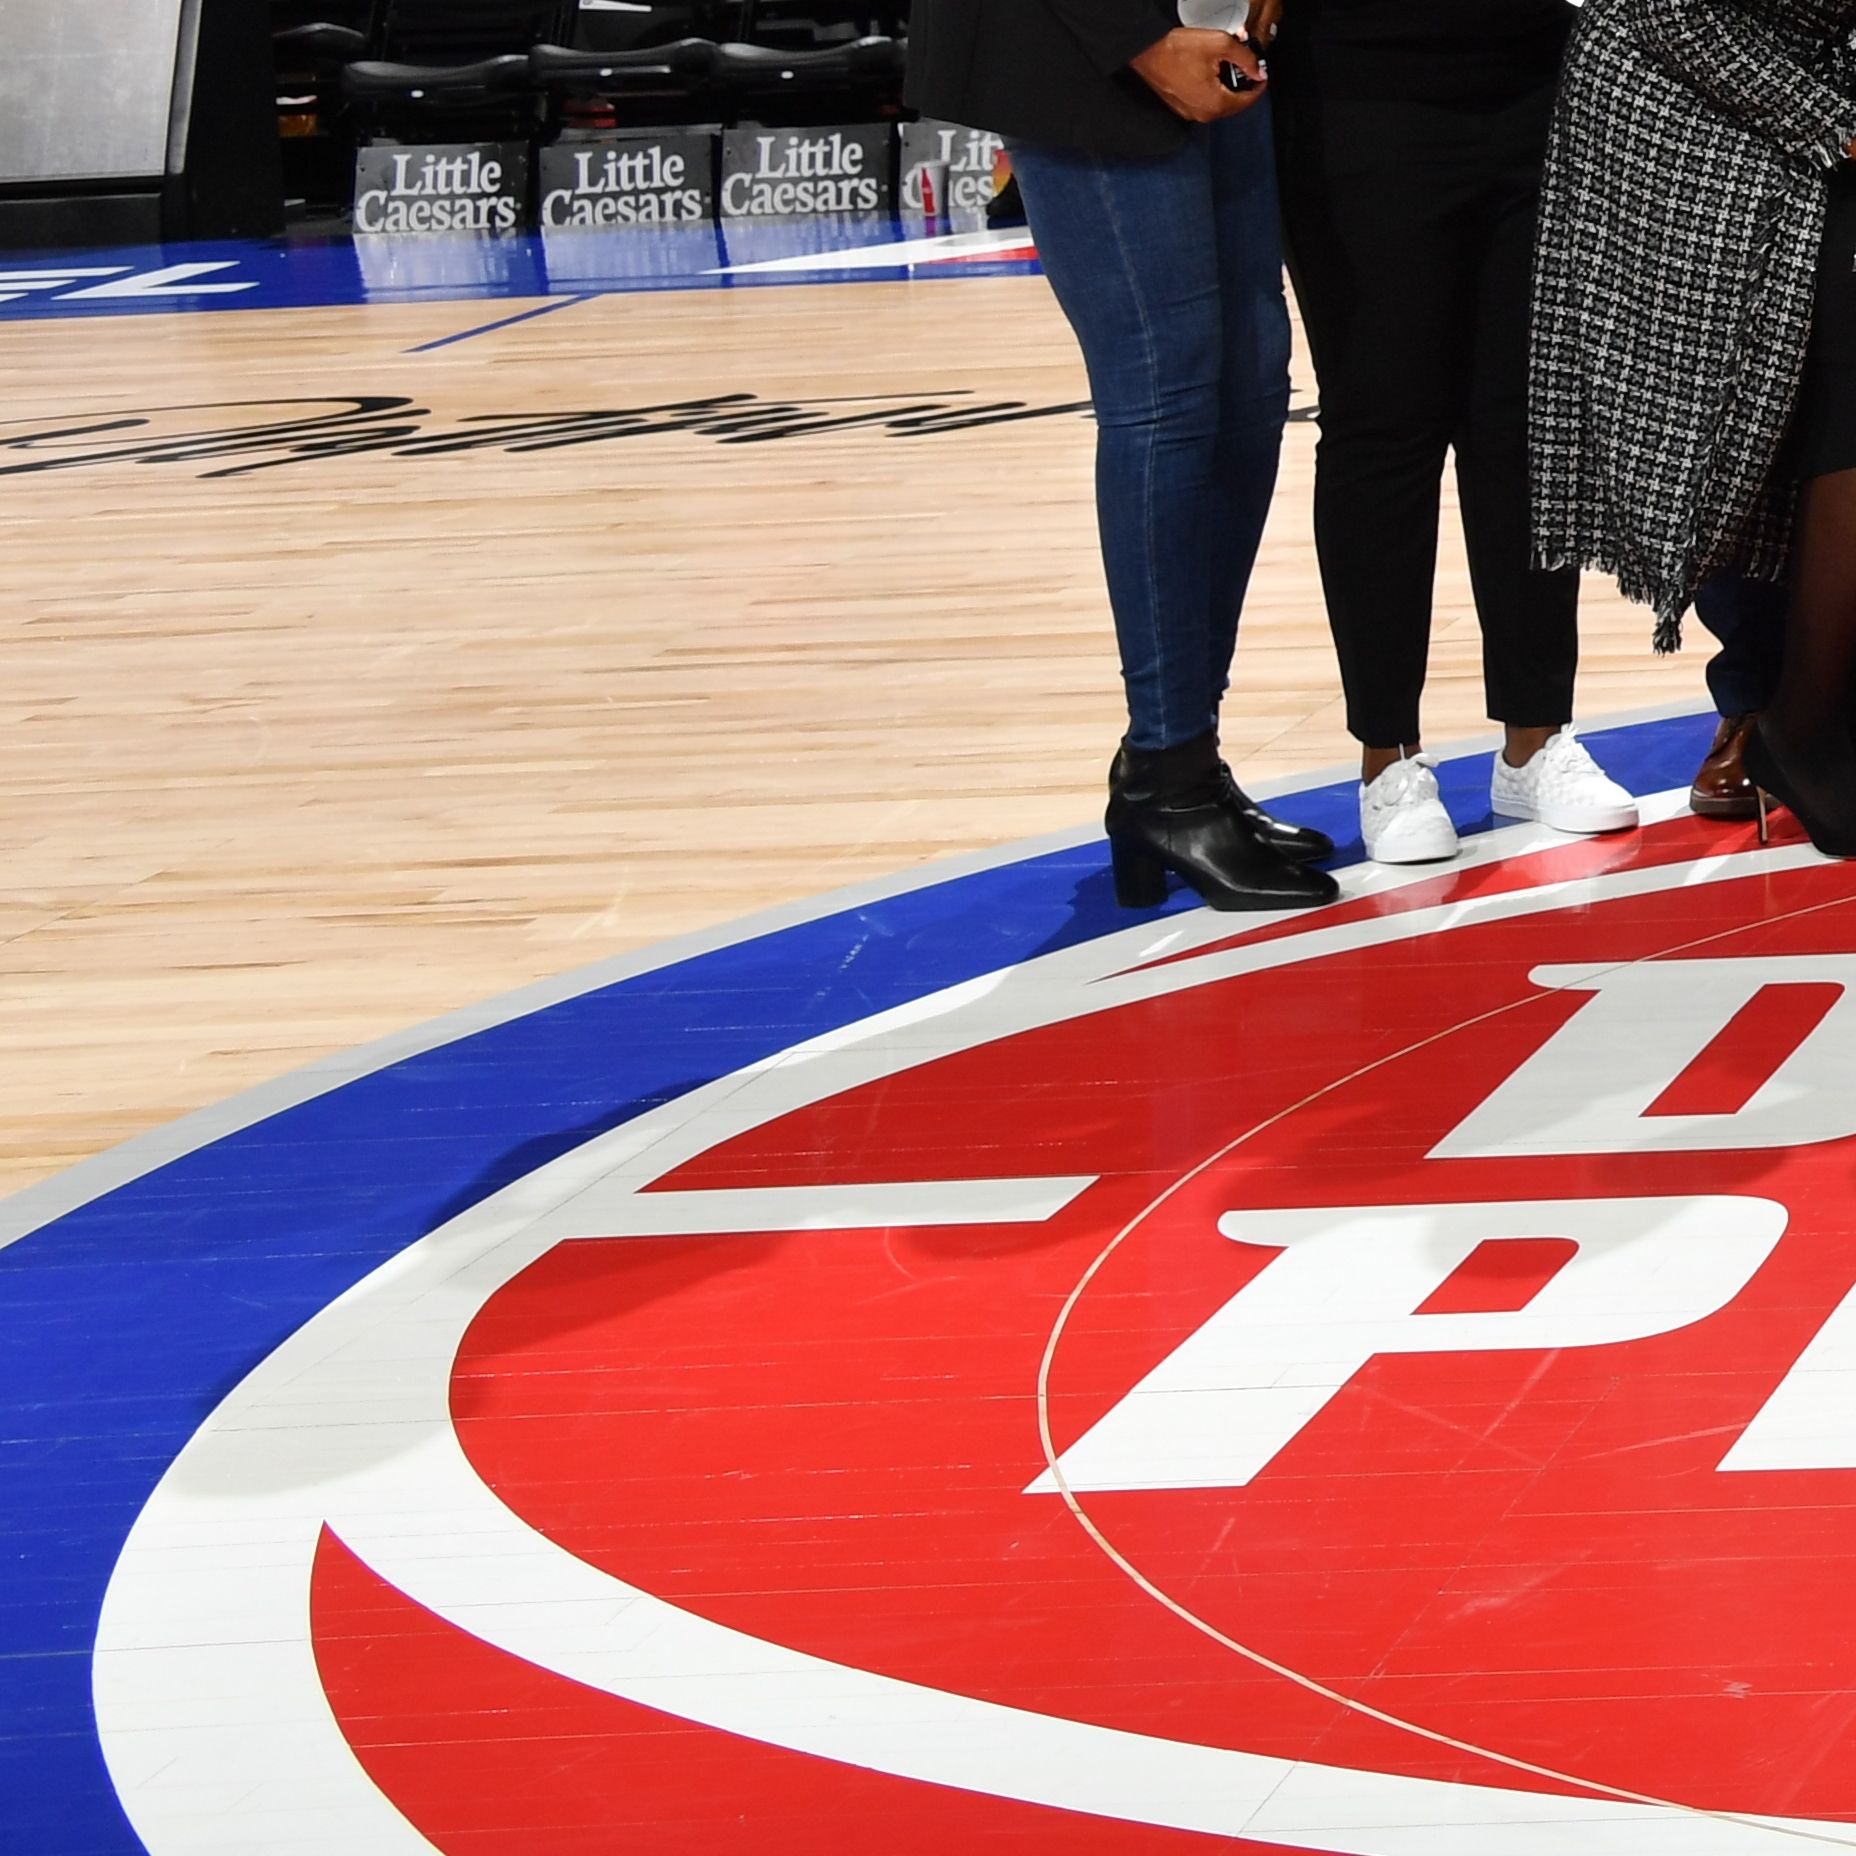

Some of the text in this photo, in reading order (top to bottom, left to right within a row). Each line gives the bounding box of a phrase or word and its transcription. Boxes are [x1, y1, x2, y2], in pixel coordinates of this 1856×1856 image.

[390, 151, 503, 197] Little
[573, 145, 687, 195] Little
[755, 134, 864, 181] Little
[355, 194, 518, 234] Caesars
[541, 186, 703, 227] Caesars
[720, 171, 879, 218] Caesars
